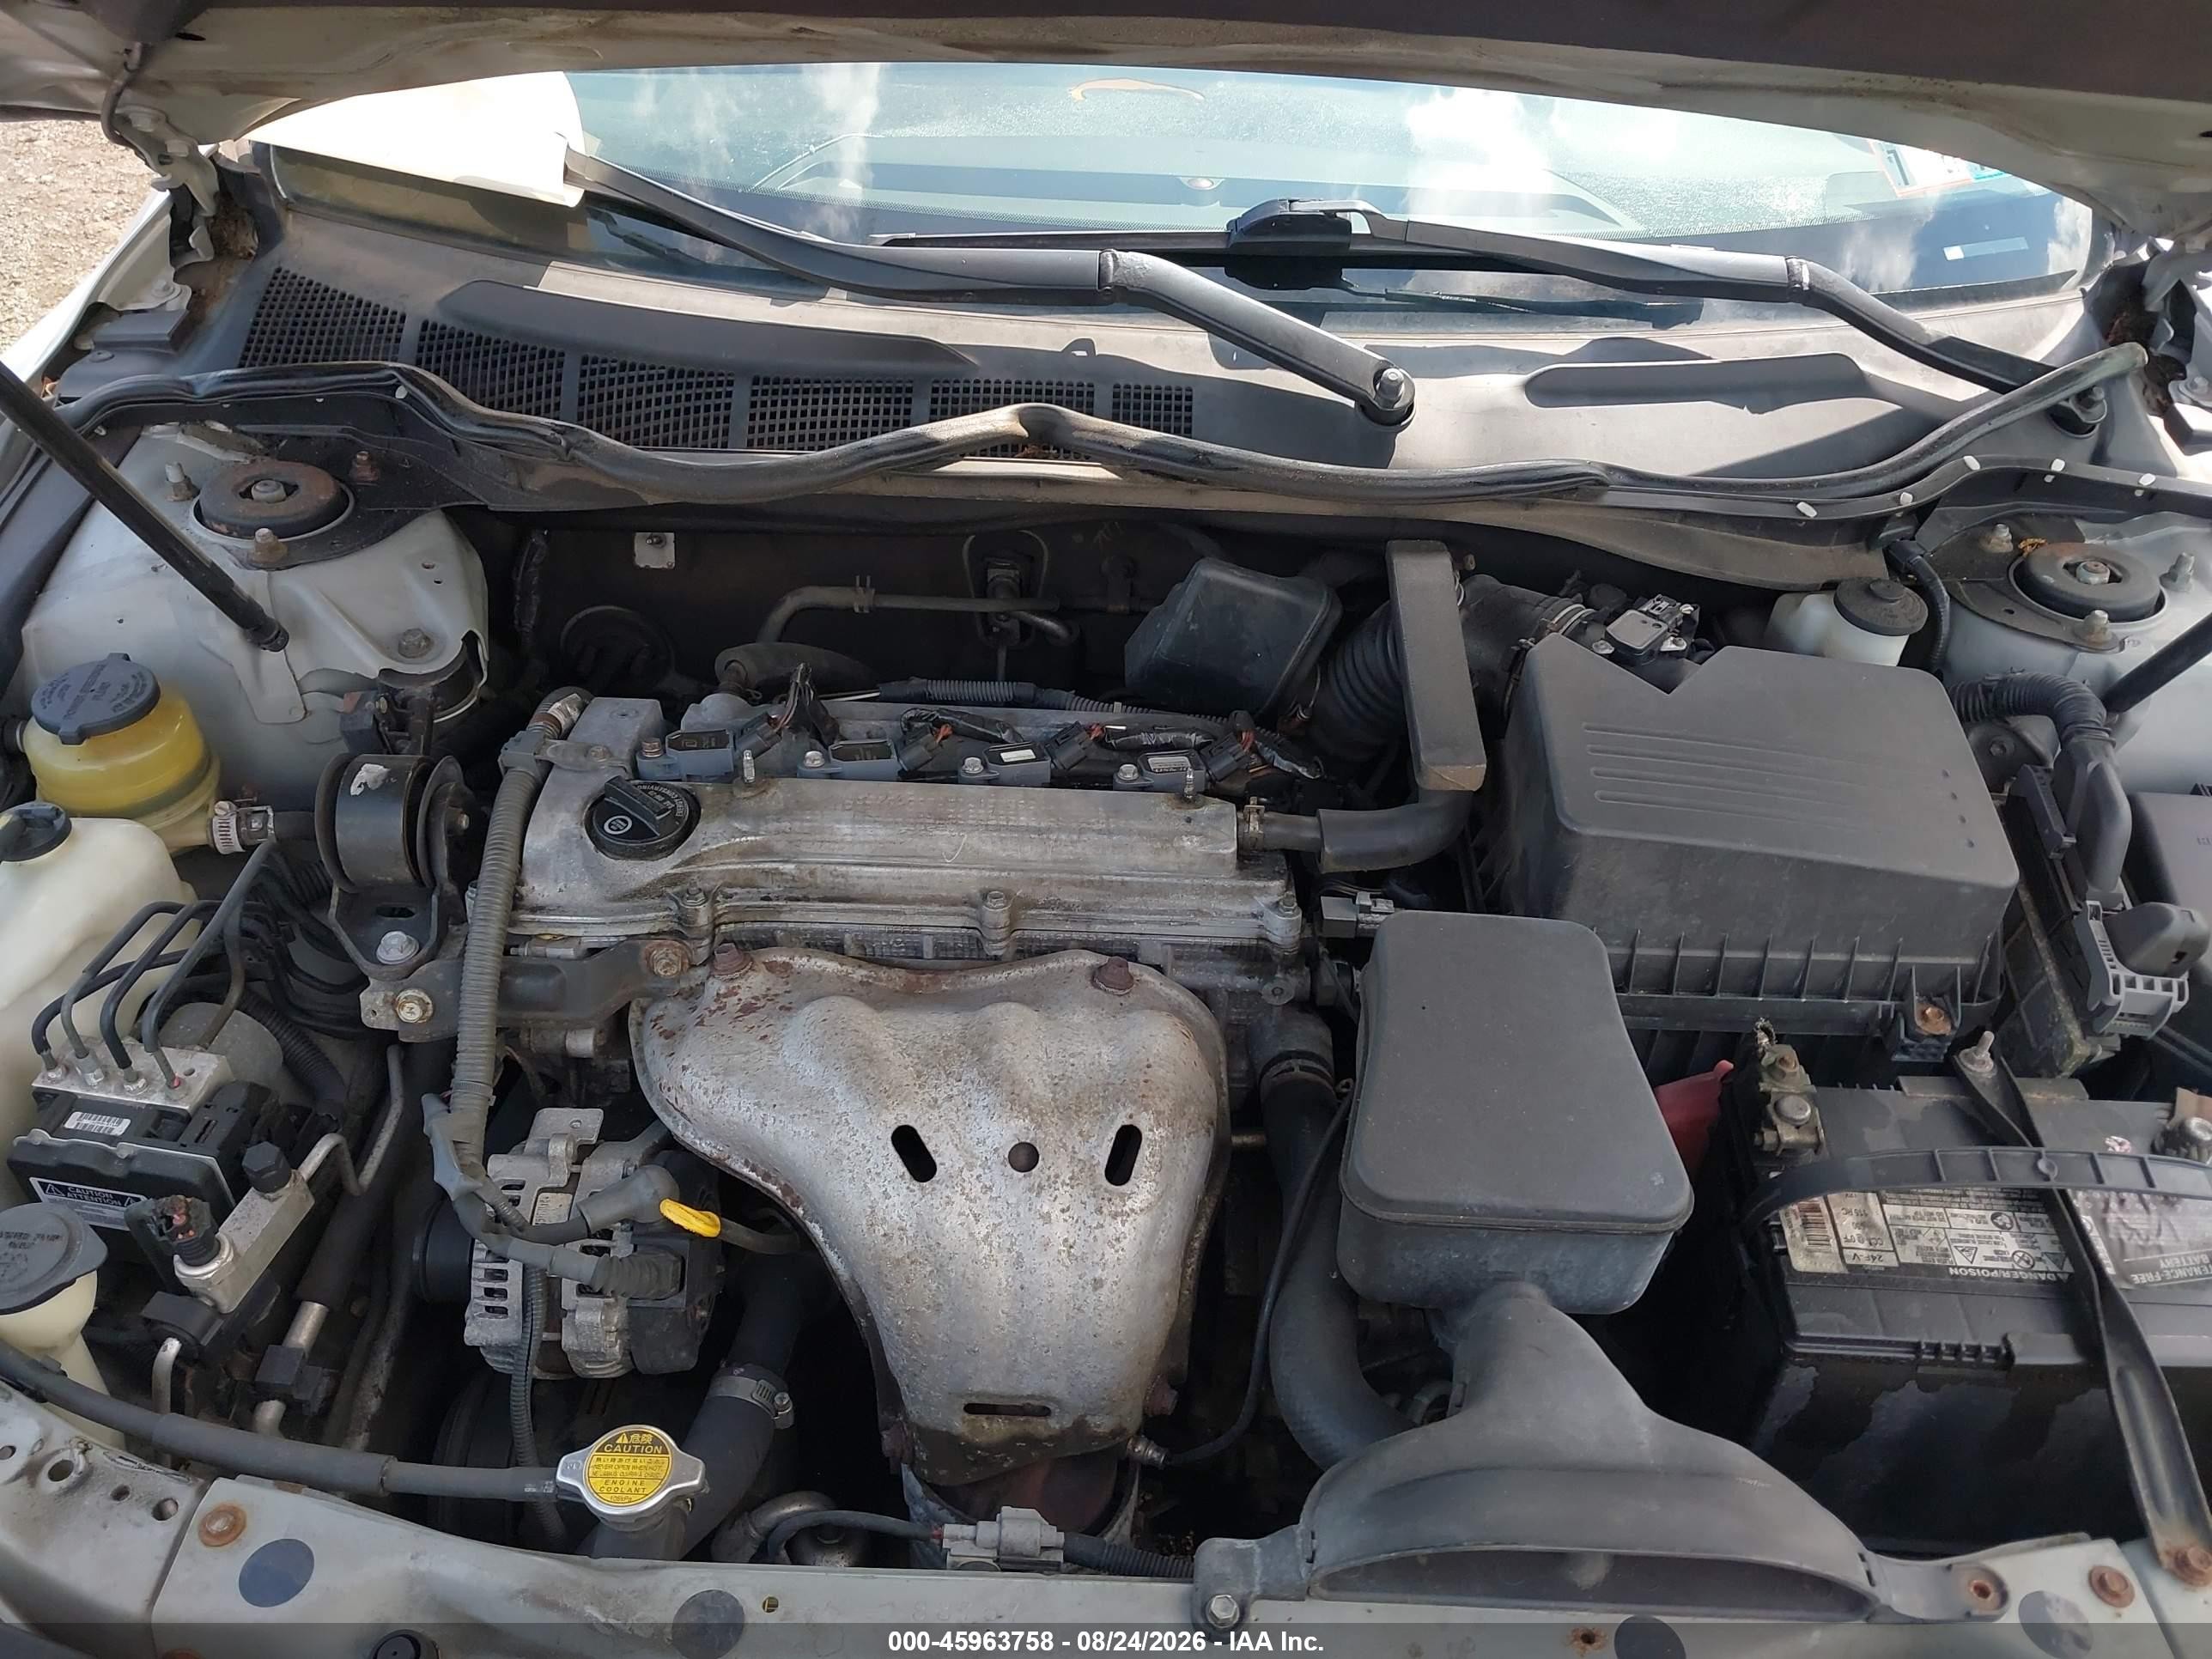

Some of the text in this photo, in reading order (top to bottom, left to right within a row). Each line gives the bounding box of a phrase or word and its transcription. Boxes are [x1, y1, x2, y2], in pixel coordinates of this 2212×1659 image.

[67, 1193, 121, 1206] ATTENTION
[68, 1188, 113, 1199] CAUTION
[2160, 1255, 2210, 1268] BATTERY
[1949, 1267, 2057, 1280] DANGER/POISON
[604, 1444, 662, 1454] CAUTION
